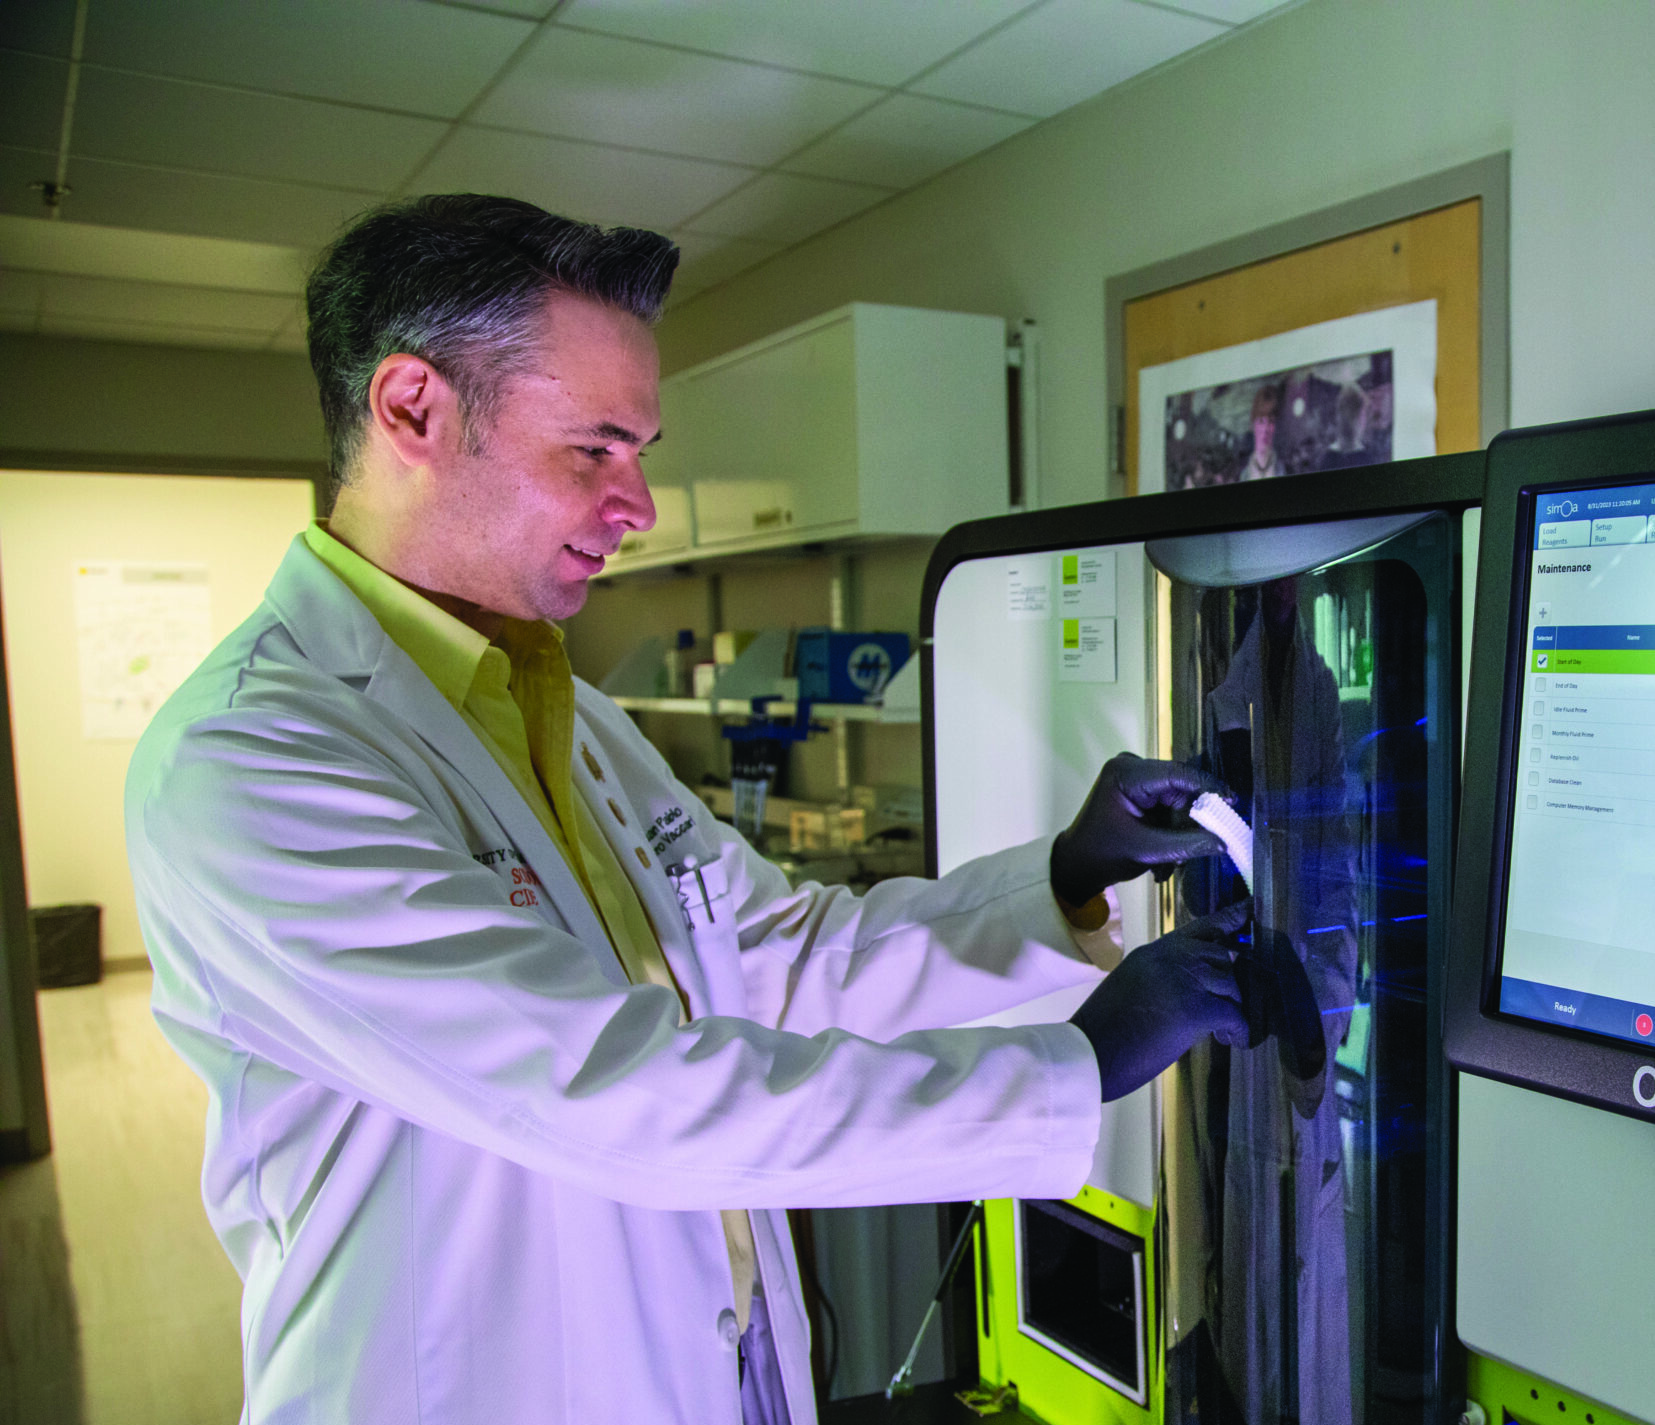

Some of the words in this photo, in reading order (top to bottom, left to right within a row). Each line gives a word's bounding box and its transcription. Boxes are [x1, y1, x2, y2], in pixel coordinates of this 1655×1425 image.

[1543, 527, 1557, 535] Load
[1595, 523, 1612, 531] Setup
[1542, 537, 1568, 546] Reagents
[1594, 535, 1607, 543] Run
[1537, 563, 1592, 574] Maintenance
[656, 807, 682, 830] Pablo
[1554, 1001, 1577, 1016] Ready
